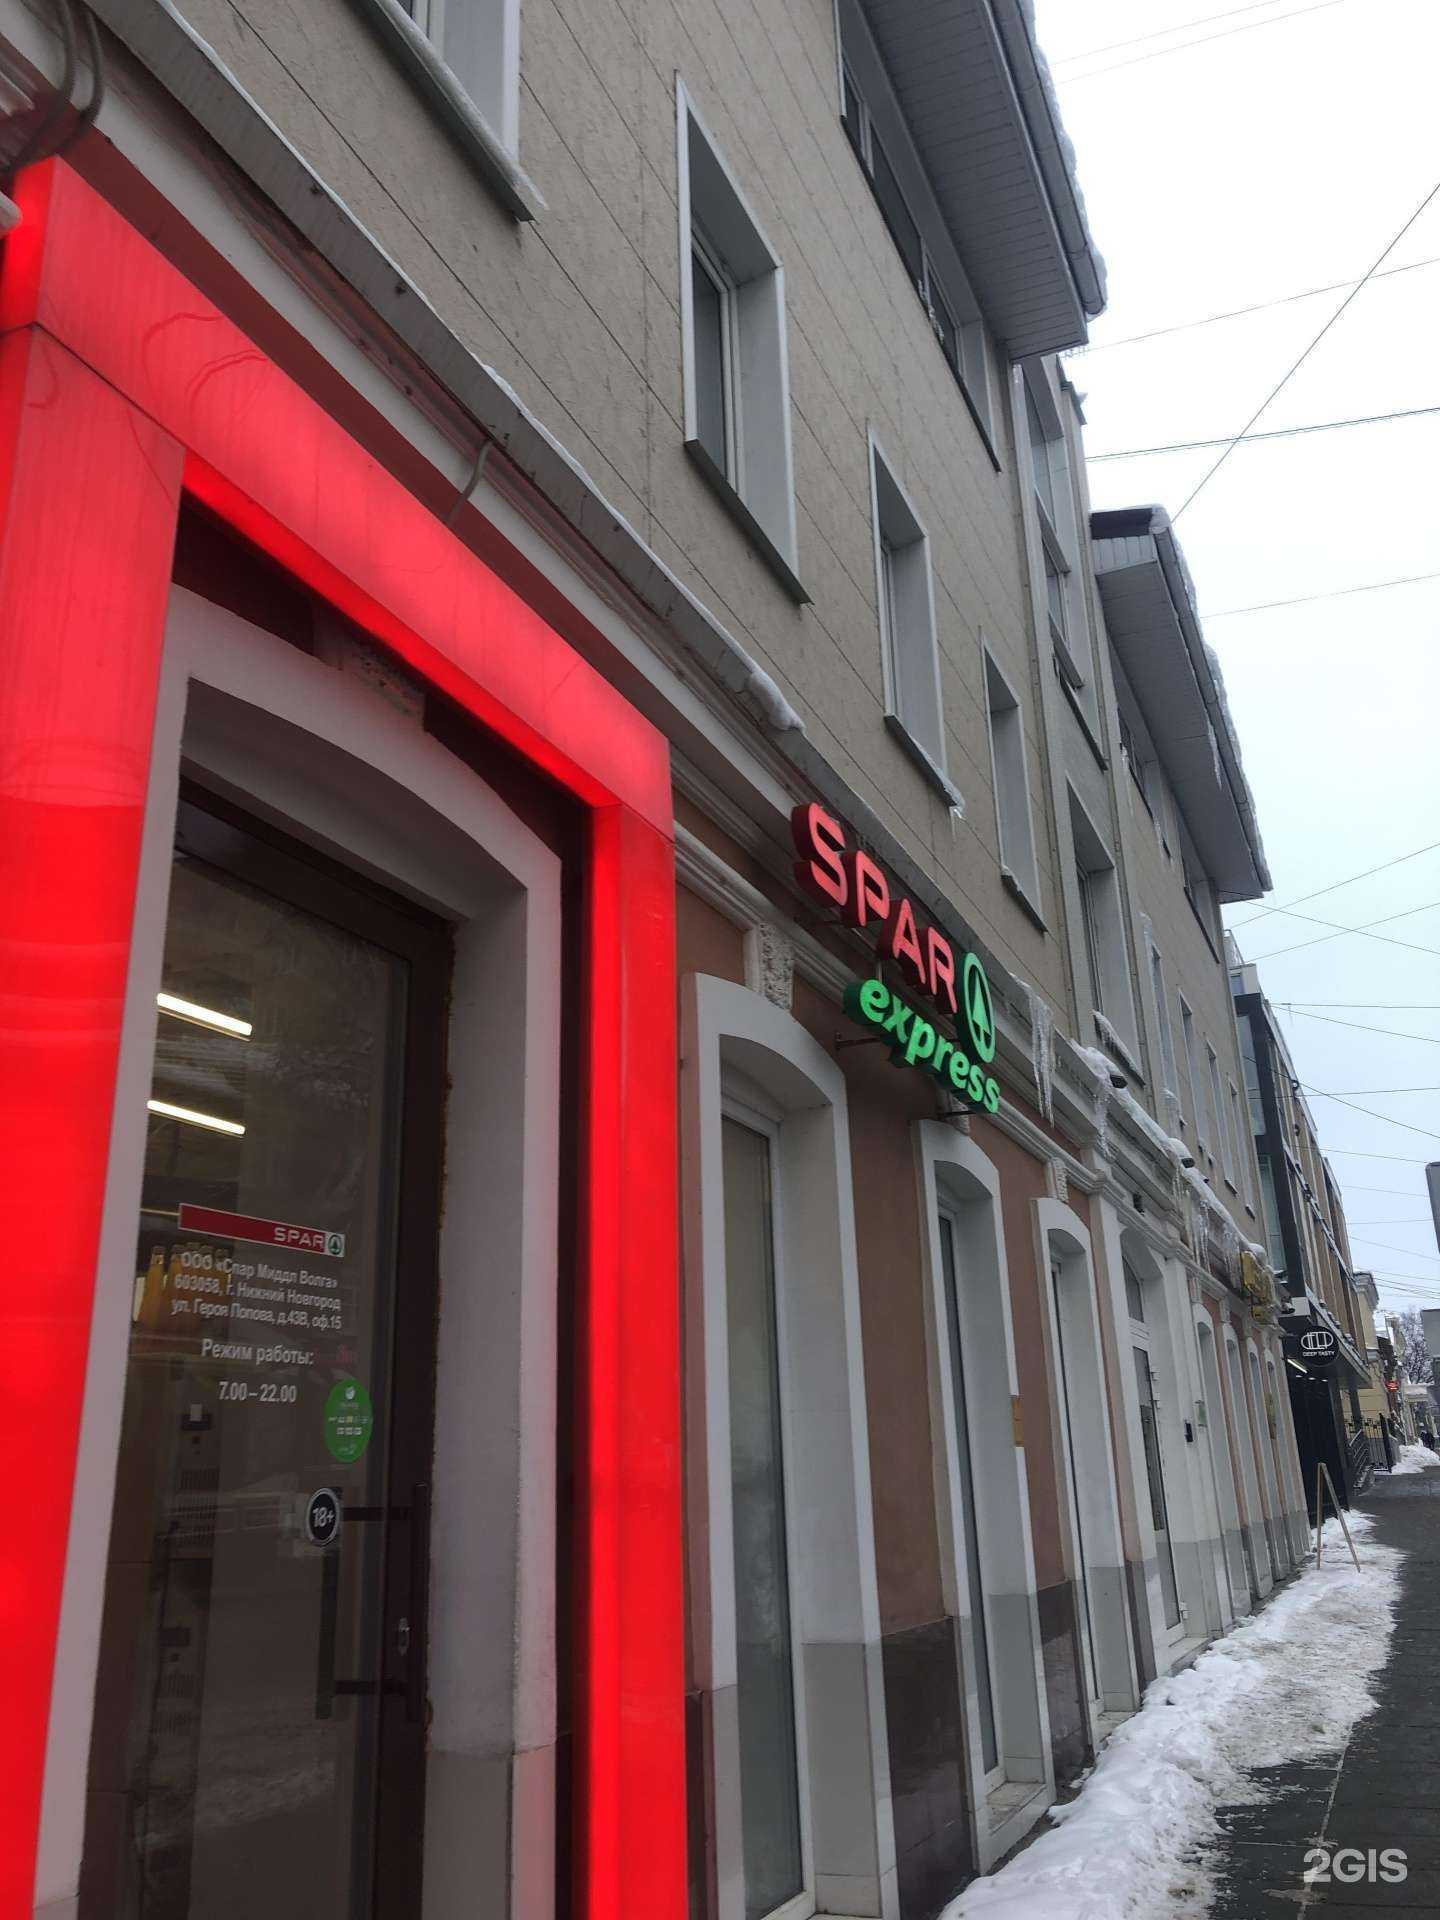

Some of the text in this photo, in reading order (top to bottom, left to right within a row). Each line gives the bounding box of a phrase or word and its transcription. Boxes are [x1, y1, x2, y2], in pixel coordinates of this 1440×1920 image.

[807, 802, 957, 1013] SPAR
[859, 979, 1000, 1114] express
[273, 1226, 325, 1249] SPAR
[181, 1251, 213, 1270] ООО
[257, 1263, 297, 1284] Миддл
[237, 1281, 285, 1302] Нижний
[287, 1288, 341, 1312] Новгород
[201, 1338, 315, 1366] Режим работы:
[312, 1506, 335, 1528] 18+
